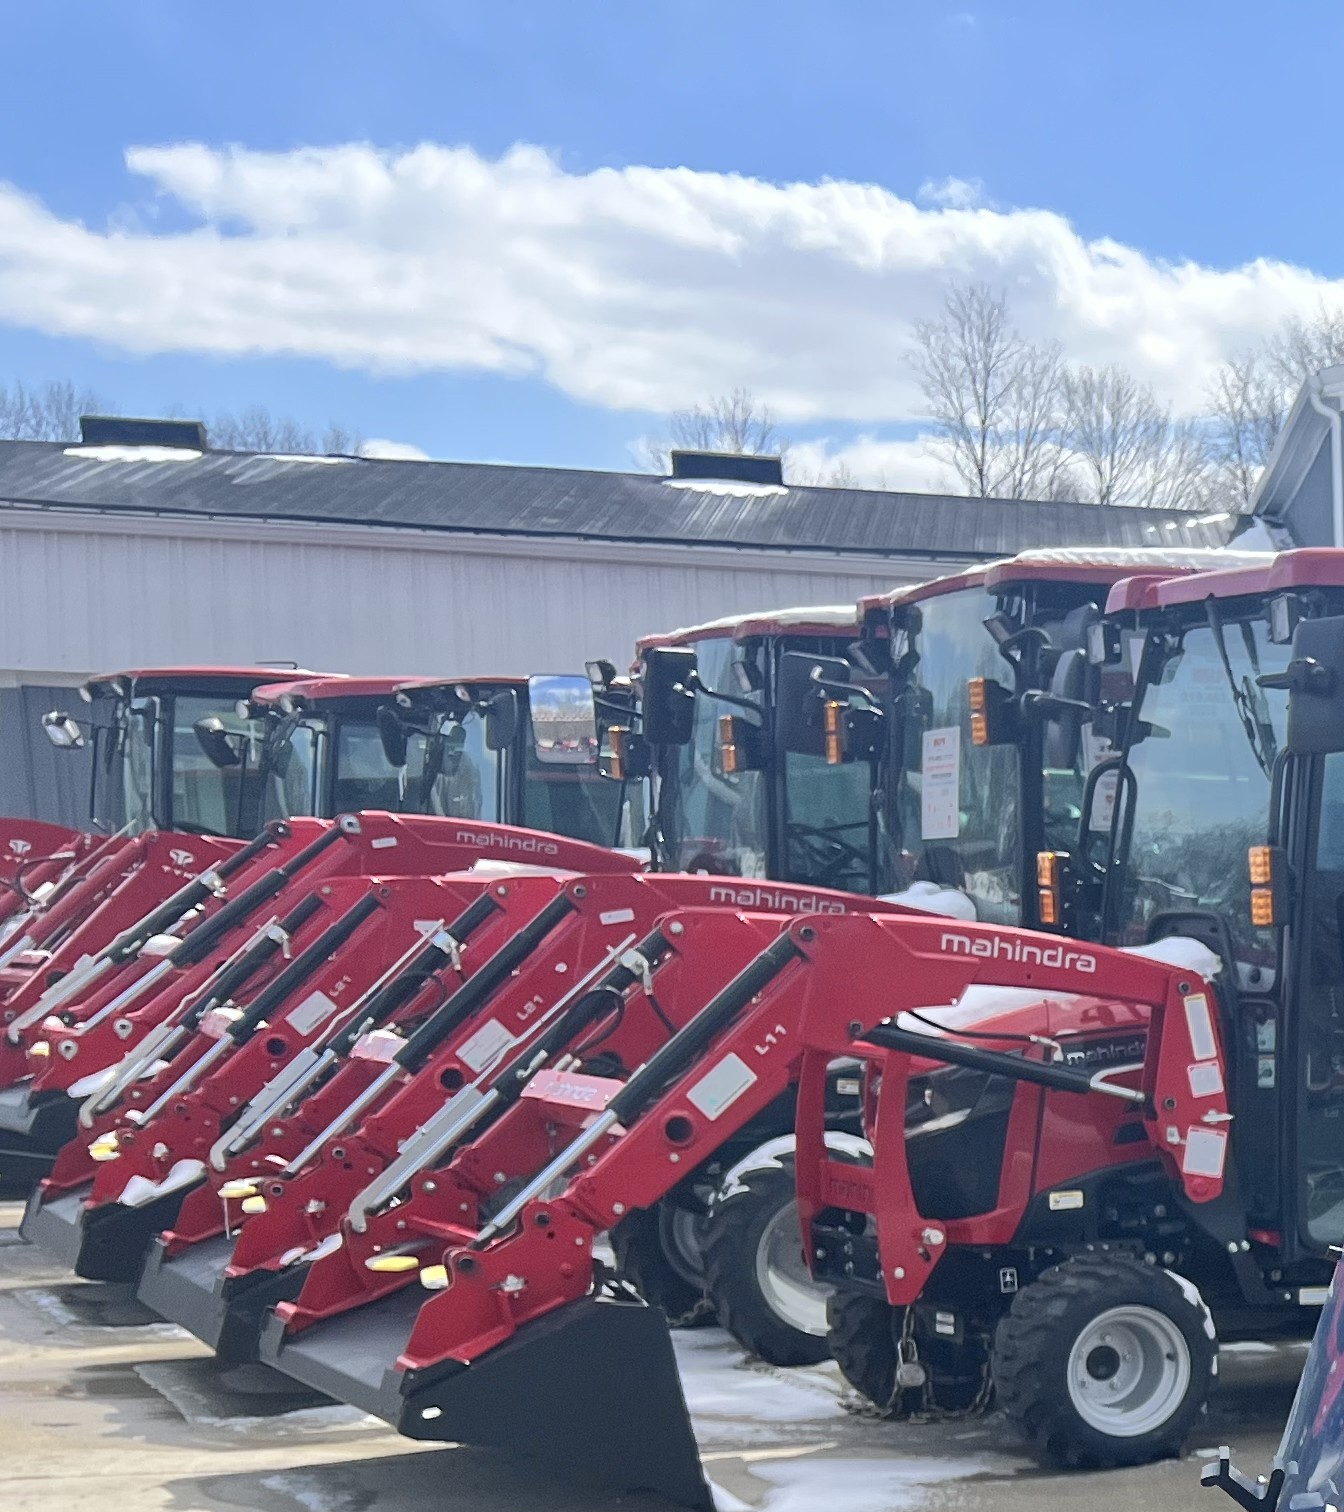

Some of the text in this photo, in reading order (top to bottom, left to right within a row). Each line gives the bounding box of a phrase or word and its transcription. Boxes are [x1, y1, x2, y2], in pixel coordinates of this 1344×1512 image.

[456, 830, 558, 855] mahindra
[710, 885, 846, 914] mahindra
[941, 933, 1097, 973] mahindra
[1066, 1041, 1145, 1066] mahind
